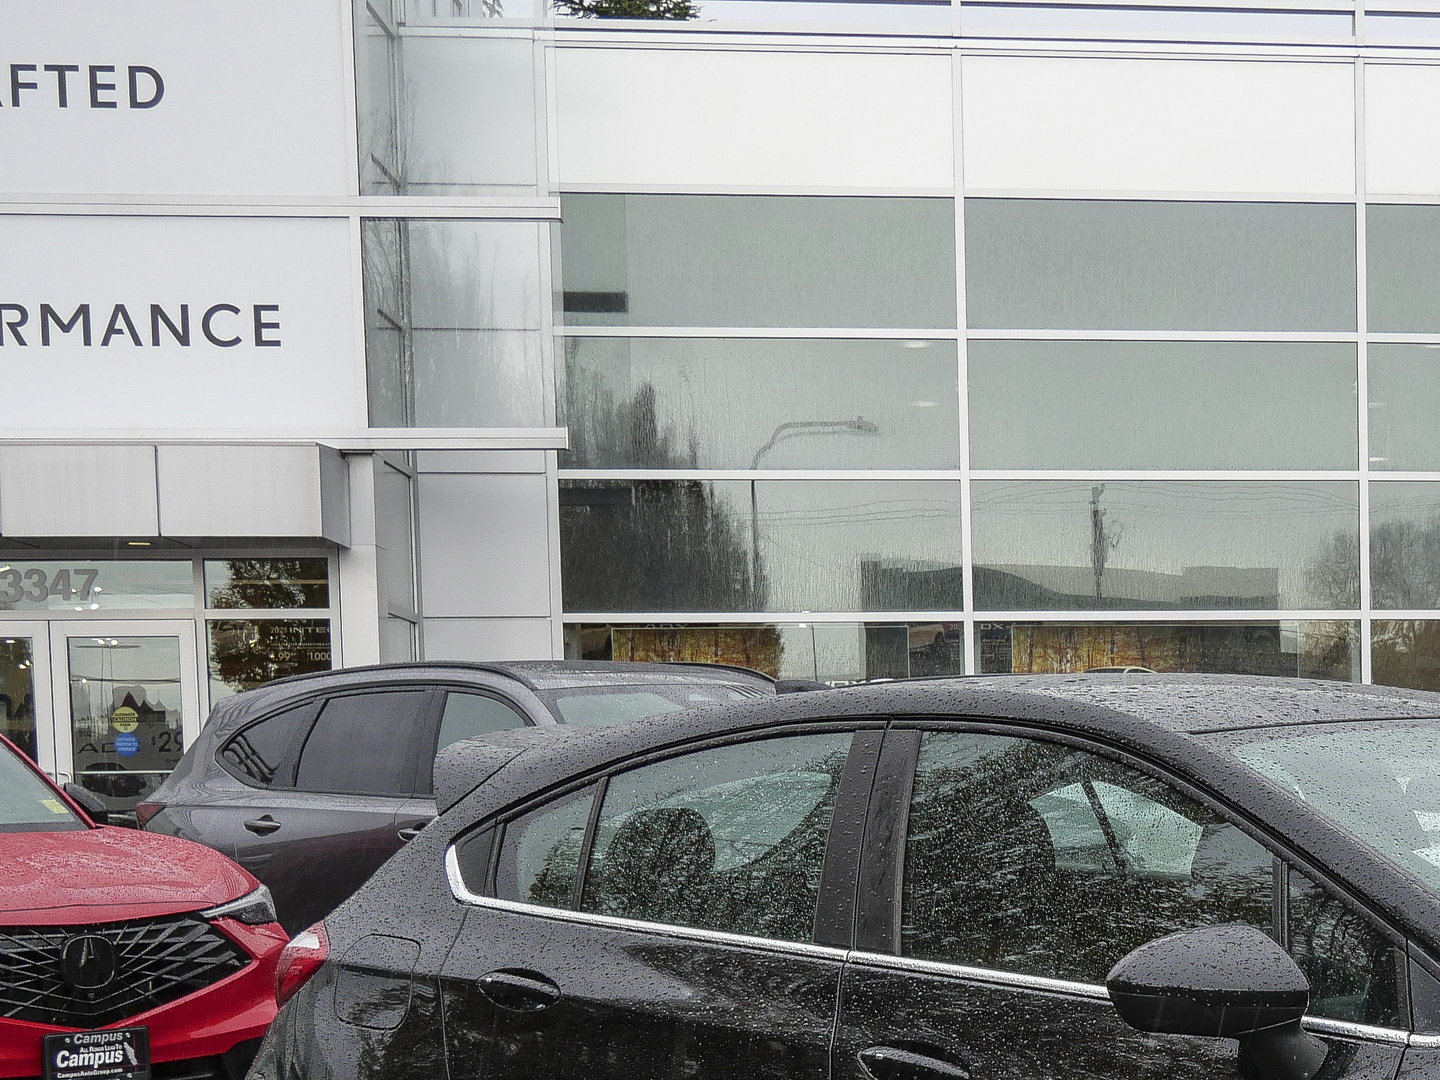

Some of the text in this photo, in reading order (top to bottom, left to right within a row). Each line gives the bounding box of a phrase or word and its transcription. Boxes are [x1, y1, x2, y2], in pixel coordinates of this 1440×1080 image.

[0, 64, 165, 109] FTED
[0, 303, 283, 348] RMANCE
[0, 568, 98, 602] 3347
[289, 626, 331, 634] INTE
[74, 1032, 123, 1045] Campus
[56, 1050, 124, 1068] Campus
